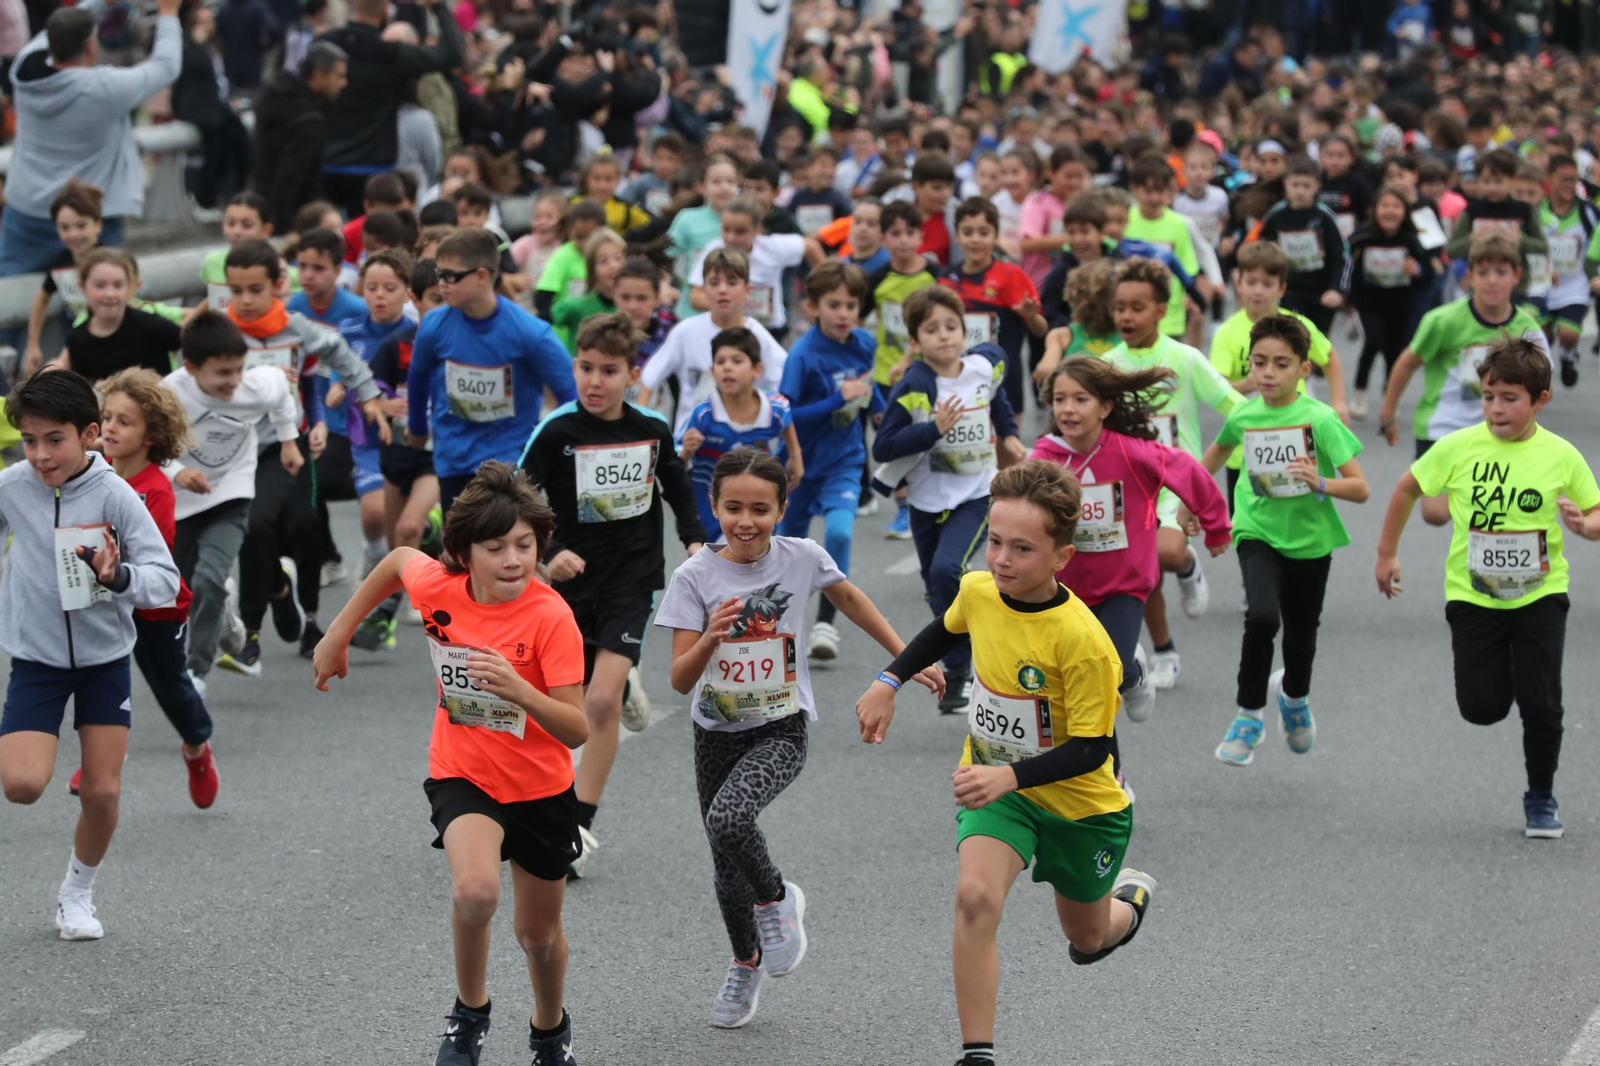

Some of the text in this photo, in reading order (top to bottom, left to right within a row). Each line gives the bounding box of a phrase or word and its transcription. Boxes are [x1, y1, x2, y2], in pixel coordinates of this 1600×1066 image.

[457, 378, 496, 395] 8407
[946, 424, 985, 443] 8563
[1255, 445, 1297, 465] 9240
[595, 462, 642, 485] 8542
[1472, 461, 1510, 485] UN
[1081, 501, 1105, 521] 85
[1468, 510, 1507, 531] DE
[1483, 549, 1531, 567] 8552
[448, 650, 471, 661] MARTÍ
[441, 664, 490, 692] 85
[719, 658, 774, 683] 9219
[766, 691, 790, 702] XLVIII
[988, 697, 1002, 707] NOEL
[492, 708, 519, 719] XLVIII
[975, 703, 1025, 740] 8596
